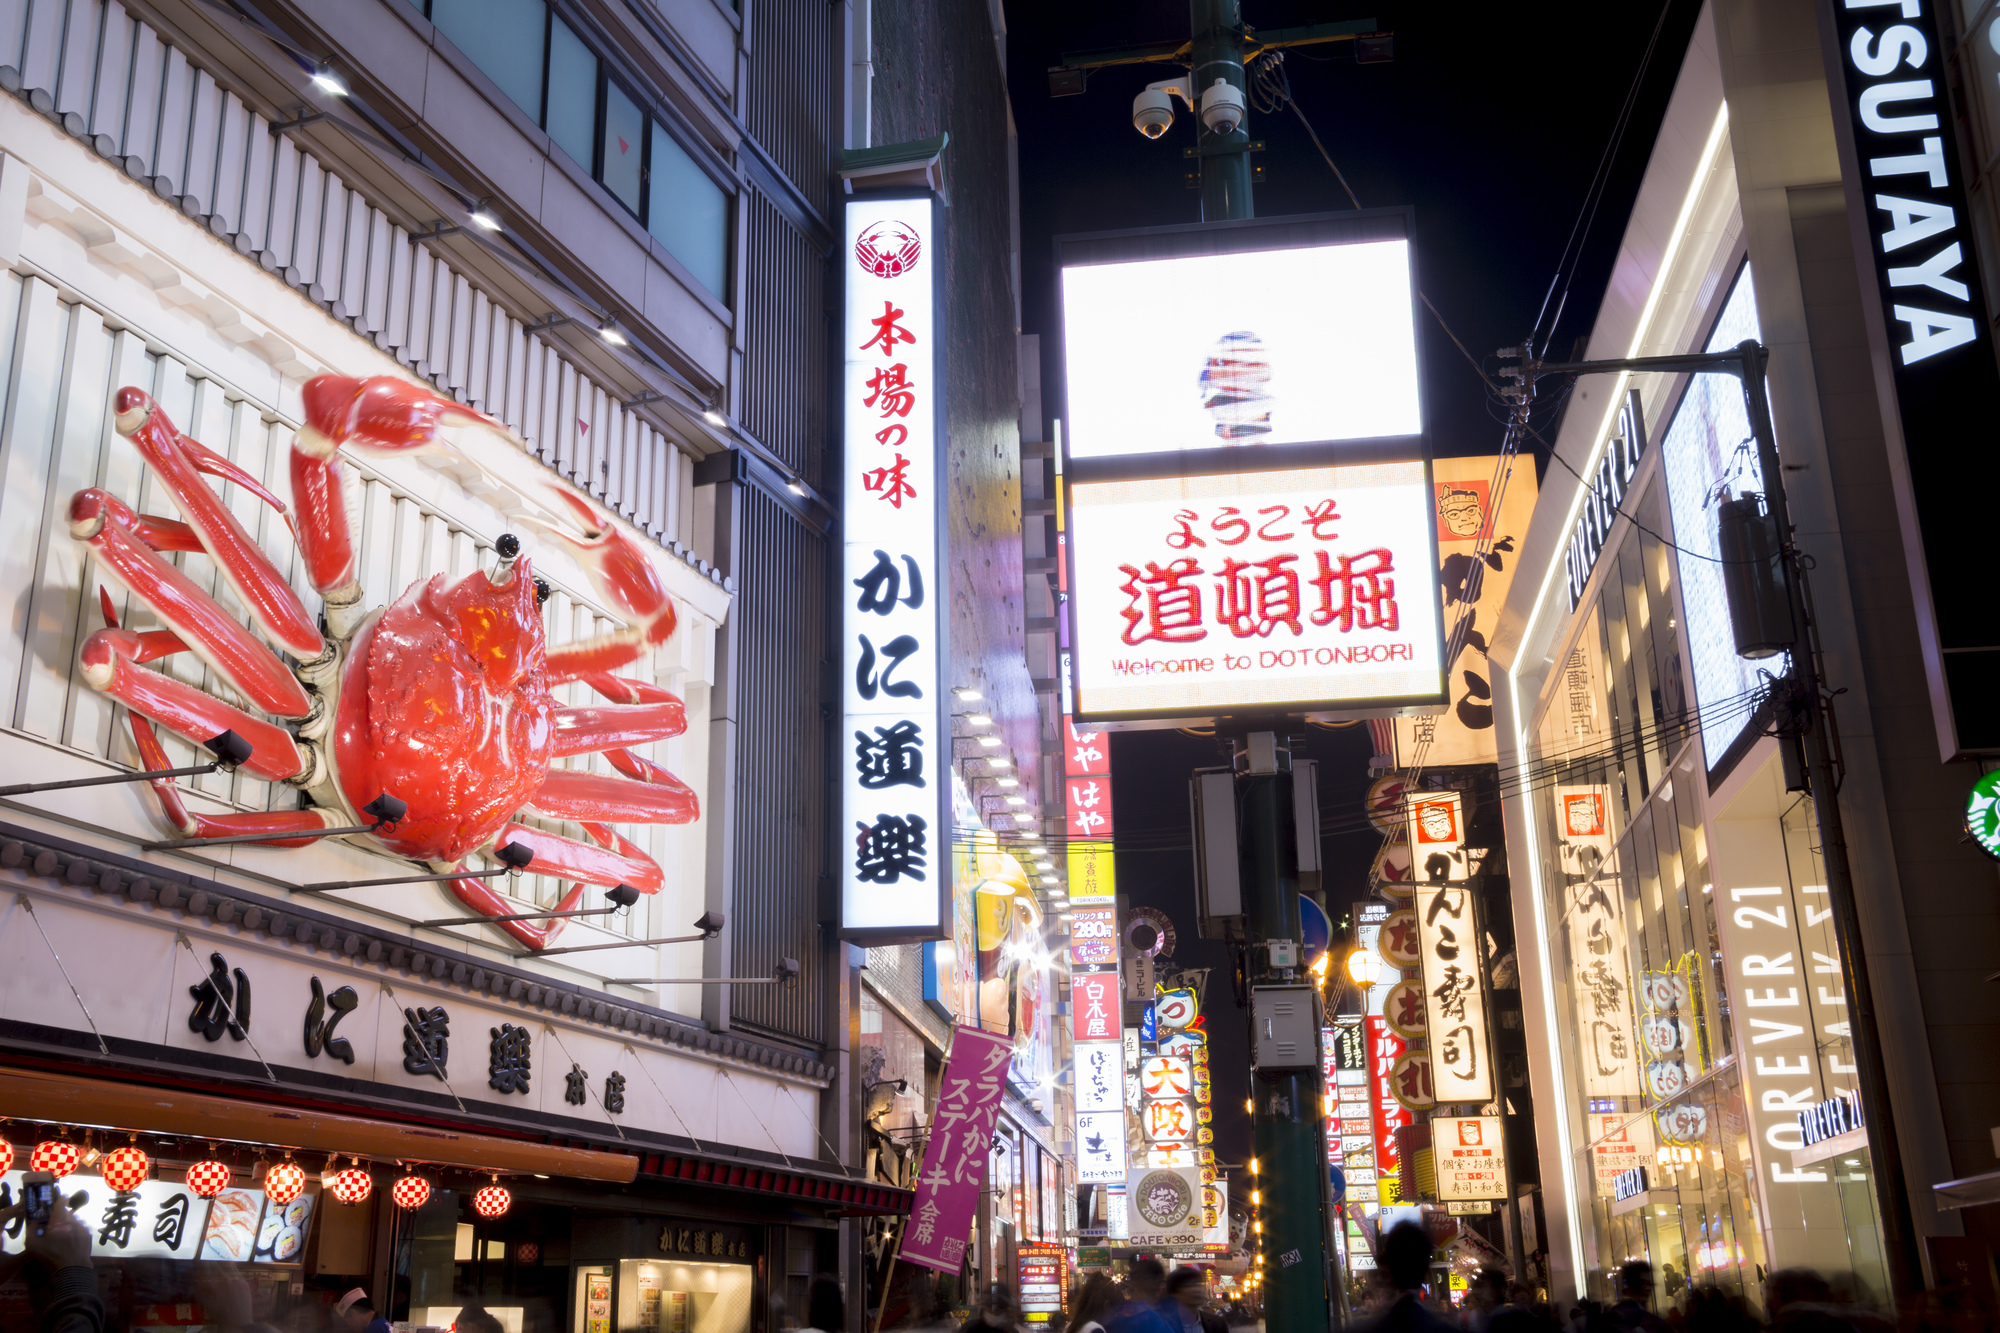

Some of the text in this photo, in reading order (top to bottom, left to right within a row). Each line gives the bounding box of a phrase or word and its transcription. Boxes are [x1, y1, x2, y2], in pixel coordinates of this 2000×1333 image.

[859, 300, 917, 510] 本場の味
[1564, 389, 1640, 614] FOREVER 21
[1165, 498, 1341, 549] ようこそ
[1118, 547, 1400, 647] 道頓堀
[1112, 642, 1414, 677] Welcome to DOTONBORI
[1072, 781, 1105, 836] はや
[1730, 886, 1788, 929] 21
[1073, 976, 1087, 987] 2F
[1089, 963, 1100, 972] 3F
[1351, 1025, 1363, 1068] インターネット
[1741, 951, 1828, 1183] FOREVER
[564, 1061, 626, 1114] 本店
[955, 1043, 1007, 1186] タラバかに
[1079, 1117, 1093, 1128] 6F
[1797, 1088, 1864, 1147] FOREVER 21
[1140, 1174, 1188, 1196] DOUTONBORI
[1451, 1181, 1504, 1194] 寿司・和食
[1141, 1204, 1188, 1225] ZERO Cafe
[1188, 1216, 1201, 1226] 2F
[1381, 1207, 1394, 1215] B1
[1130, 1235, 1164, 1245] CAFE
